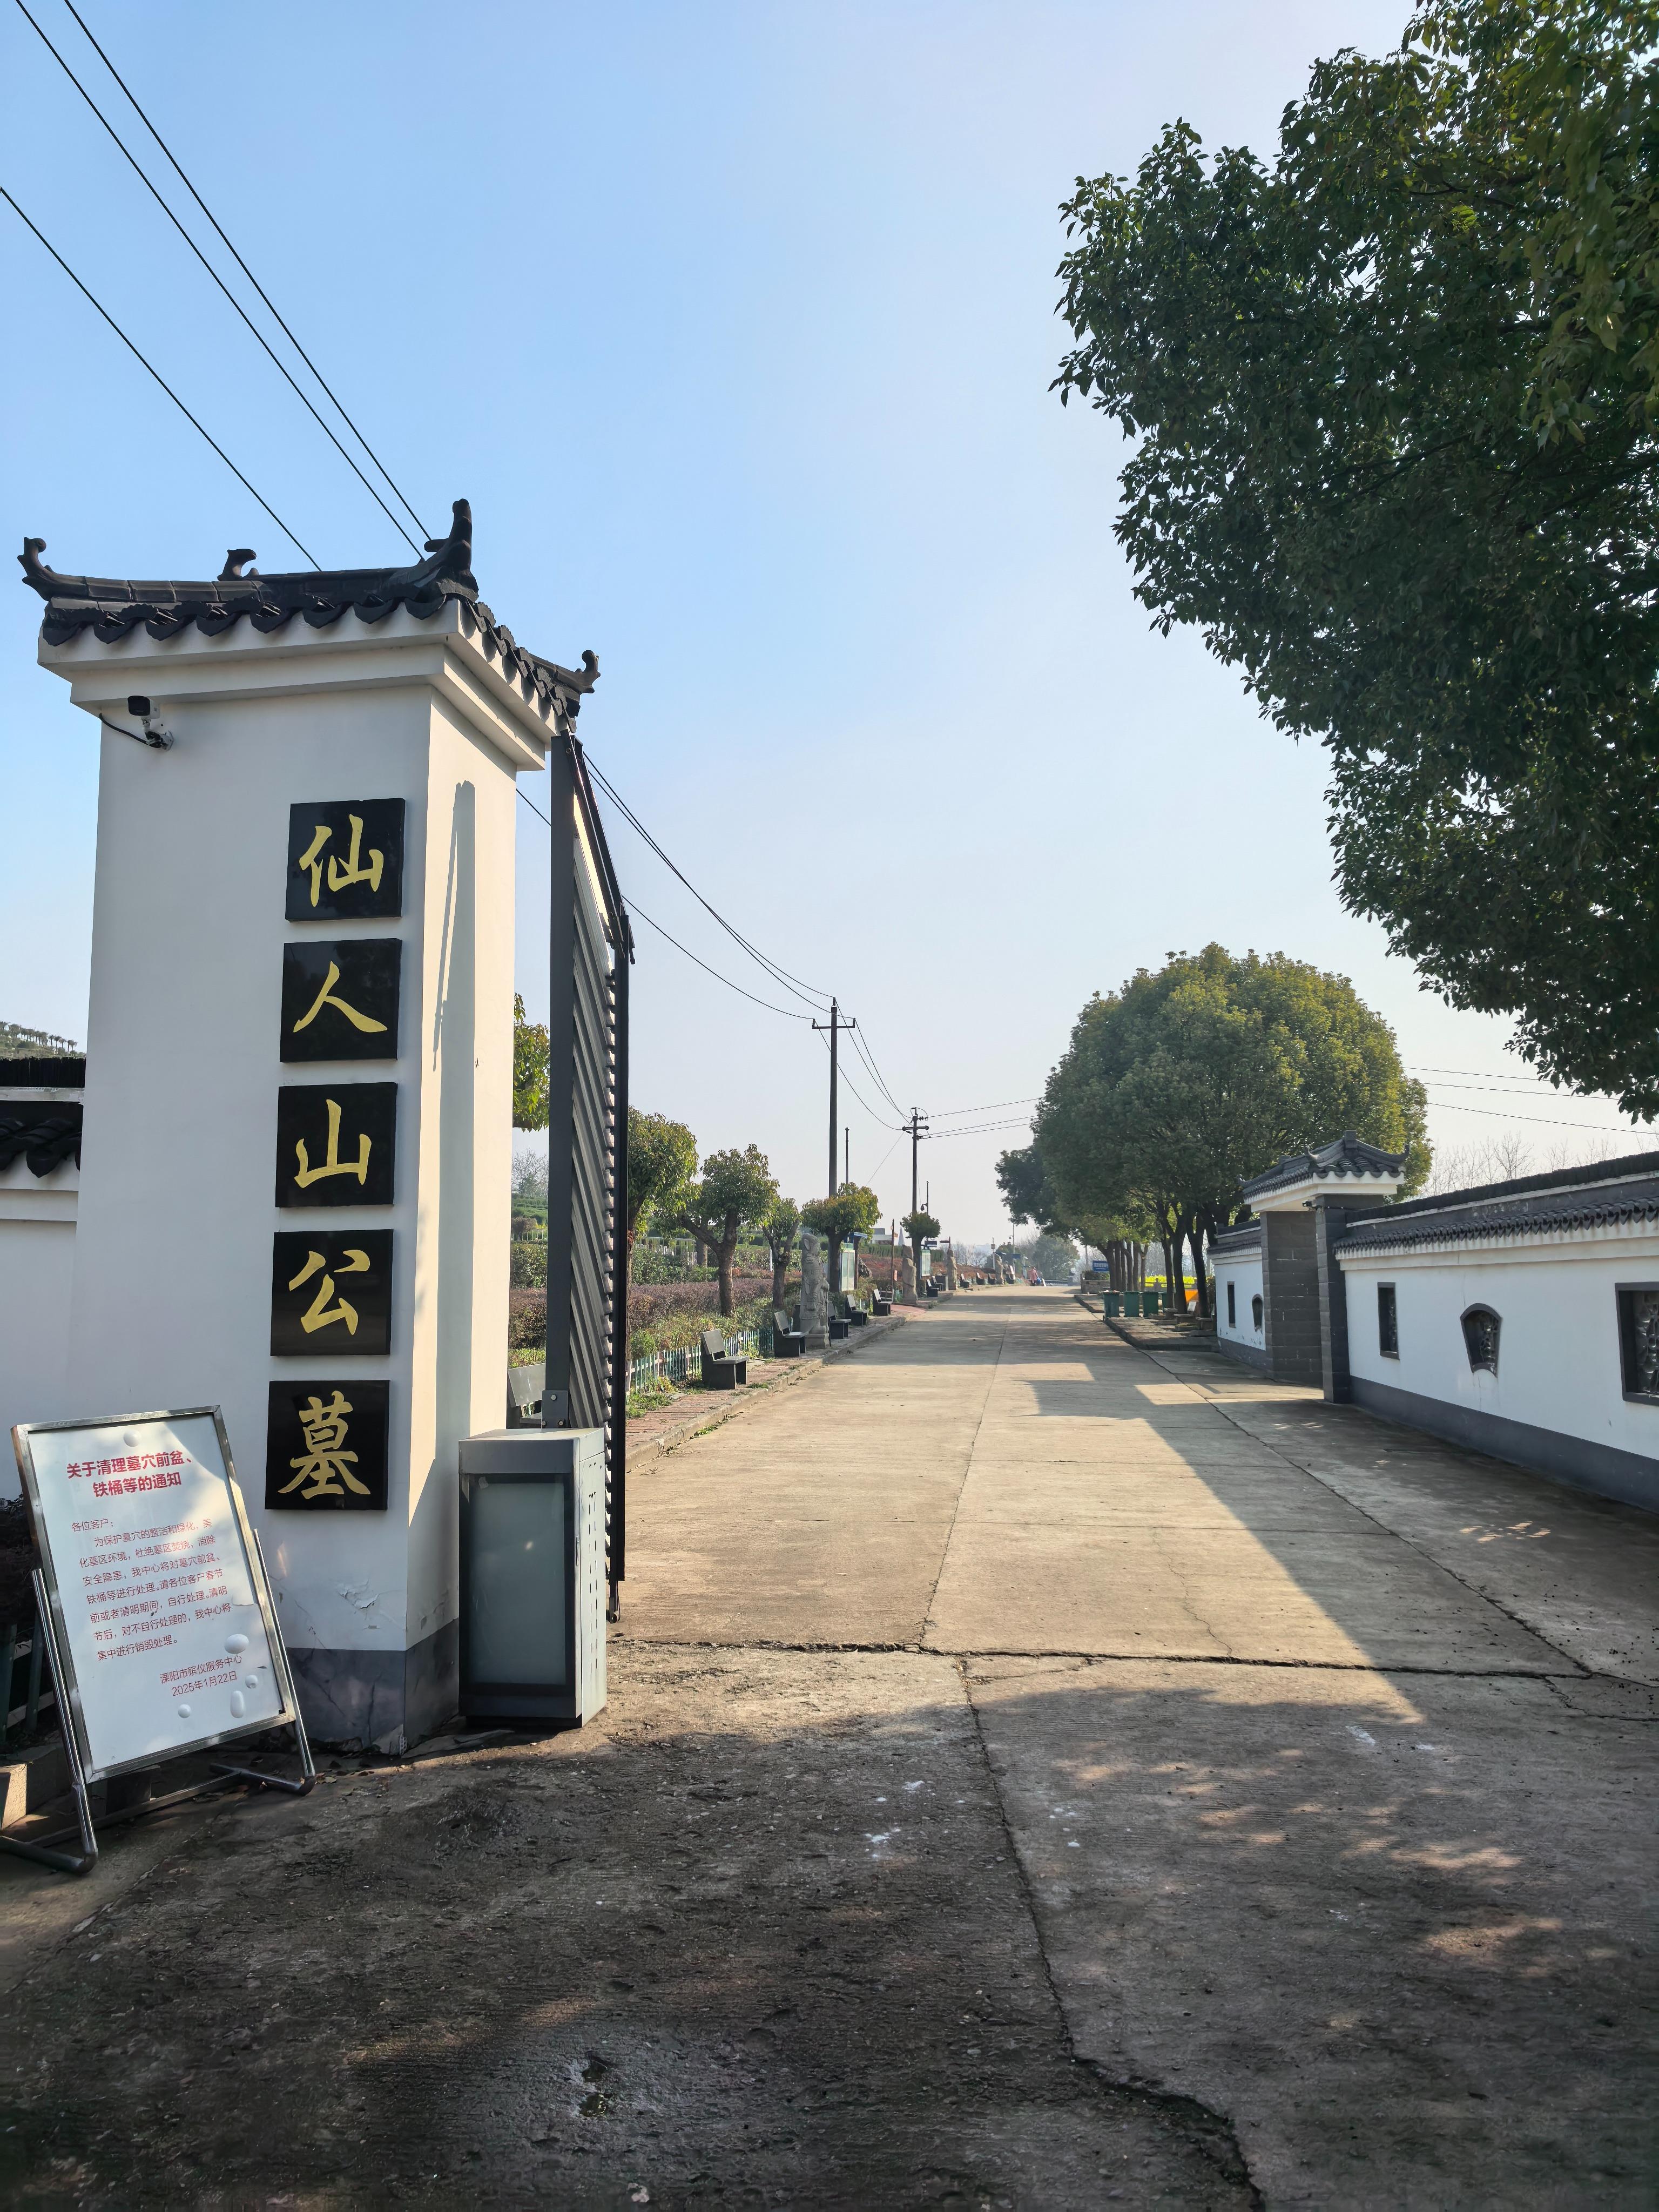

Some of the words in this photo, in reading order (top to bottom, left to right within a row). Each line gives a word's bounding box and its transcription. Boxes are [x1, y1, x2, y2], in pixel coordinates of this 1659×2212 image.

[277, 814, 388, 1500] 仙人山公墓
[66, 1451, 193, 1479] 关于清理墓穴前盆、
[92, 1472, 181, 1498] 铁桶等的通知
[160, 1655, 242, 1684] 溧阳市殡仪服务中心
[171, 1670, 237, 1696] 2025年1月22日
